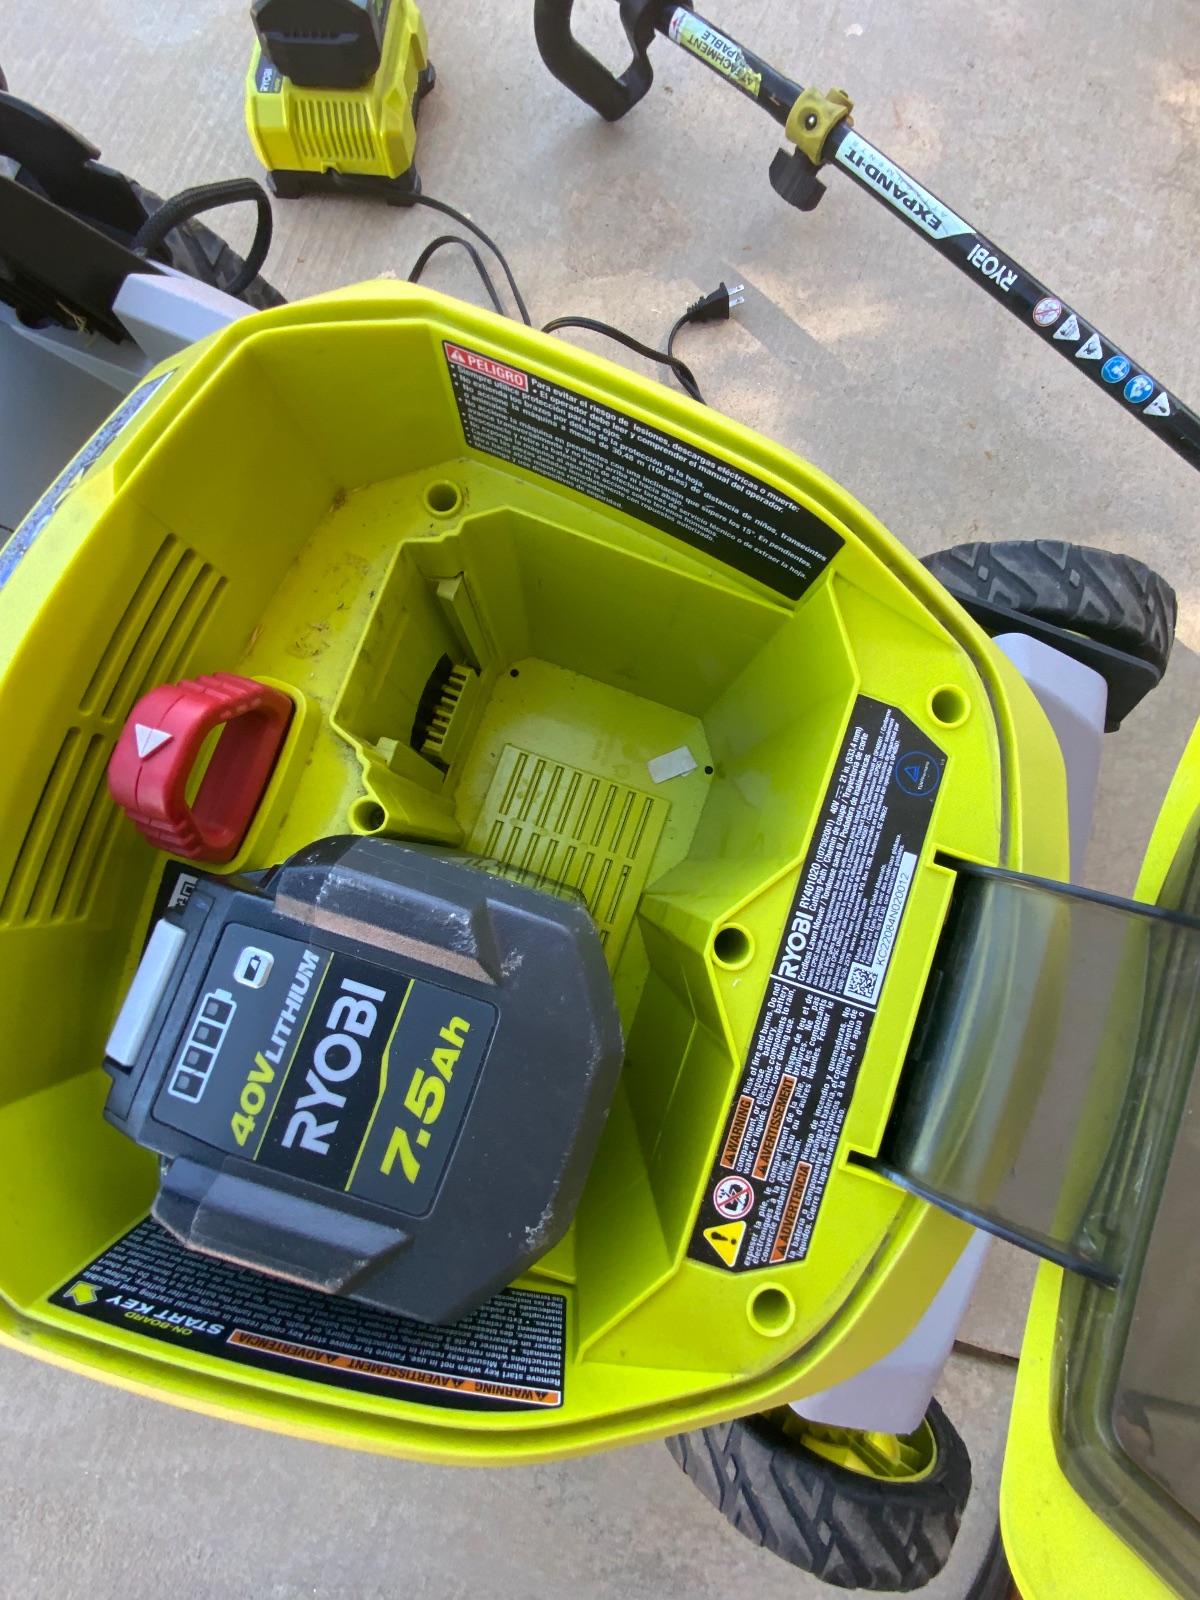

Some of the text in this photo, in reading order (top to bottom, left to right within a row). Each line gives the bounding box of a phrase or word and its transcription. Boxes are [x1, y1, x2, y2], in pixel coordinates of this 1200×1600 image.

[686, 32, 756, 86] ATTACHMENT
[843, 146, 942, 230] EXPAND-IT
[966, 243, 1018, 292] RYOBI
[465, 353, 525, 387] PELIGRO
[531, 377, 551, 392] Para
[552, 388, 578, 403] evitar
[579, 400, 587, 408] el
[589, 404, 616, 421] riesgo
[618, 417, 629, 426] de
[633, 423, 670, 447] lesiones,
[672, 443, 716, 469] descargas
[717, 465, 758, 490] eléctricas
[766, 491, 800, 512] muerte:
[539, 390, 783, 513] El operador debe leer y comprender el manual del operador.
[852, 726, 863, 743] mm)
[838, 774, 847, 783] 21
[841, 765, 851, 774] in.
[808, 732, 869, 912] Cutting Path Chemin de coupe Trayectoria de corte
[829, 799, 840, 814] 40V
[815, 819, 836, 863] (107592001)
[797, 753, 871, 981] Cordless Lawn Mower Tondeuse sans fil Podadora de inalámbricas
[798, 862, 821, 909] RY401020
[777, 910, 814, 979] RYOBI
[804, 1019, 814, 1031] Ne
[811, 996, 820, 1012] pas
[825, 1000, 834, 1009] le
[841, 1006, 851, 1018] No
[849, 1009, 858, 1019] de
[742, 982, 781, 1094] Risk of fire and burns. Do not
[750, 984, 790, 1096] expose battery, battery
[784, 993, 813, 1074] Risque de feu et de
[815, 1012, 830, 1041] Fermer
[230, 949, 320, 1146] 40V LITHIUM
[804, 1046, 822, 1079] liquides.
[827, 1021, 848, 1072] quemaduras.
[830, 1019, 857, 1080] compartimento
[281, 977, 386, 1155] RYOBI
[735, 988, 796, 1172] compartment, or electronic components to rain,
[380, 1016, 470, 1184] 7.5Ah
[742, 1017, 795, 1174] water, or liquids. Close cover during use.
[795, 1081, 812, 1115] d'autres
[813, 1083, 830, 1117] incendio
[830, 1079, 838, 1089] el
[725, 1099, 751, 1154] WARNING
[743, 998, 829, 1266] exposer la pile, le compartiment de la pile, ou les composants
[759, 1076, 793, 1162] AVERTISSEMENT
[791, 1119, 800, 1130] ou
[809, 1119, 819, 1130] de
[817, 1119, 826, 1128] la
[832, 1124, 840, 1133] el
[835, 1108, 845, 1124] uso.
[781, 1133, 795, 1154] l'eau
[800, 1133, 815, 1161] Riesgo
[808, 1128, 824, 1163] exponga
[822, 1133, 838, 1165] durante
[776, 1159, 789, 1182] pluie,
[816, 1166, 828, 1185] tapa
[757, 1136, 802, 1262] couvercle pendant l'utilisation.
[771, 1185, 780, 1194] la
[777, 1164, 810, 1242] ADVERTENCIA
[813, 1186, 822, 1194] la
[806, 1195, 820, 1220] Cierre
[103, 1291, 225, 1336] START KEY
[122, 1309, 194, 1336] ON-BOARD
[237, 1332, 324, 1362] ADVERTENCIA
[429, 1359, 438, 1367] in
[346, 1357, 450, 1387] AVERTISSEMENT
[440, 1361, 455, 1369] not
[457, 1364, 481, 1373] when
[483, 1367, 500, 1377] key
[502, 1371, 523, 1380] start
[525, 1374, 561, 1387] Remove
[473, 1379, 534, 1402] WARNING
